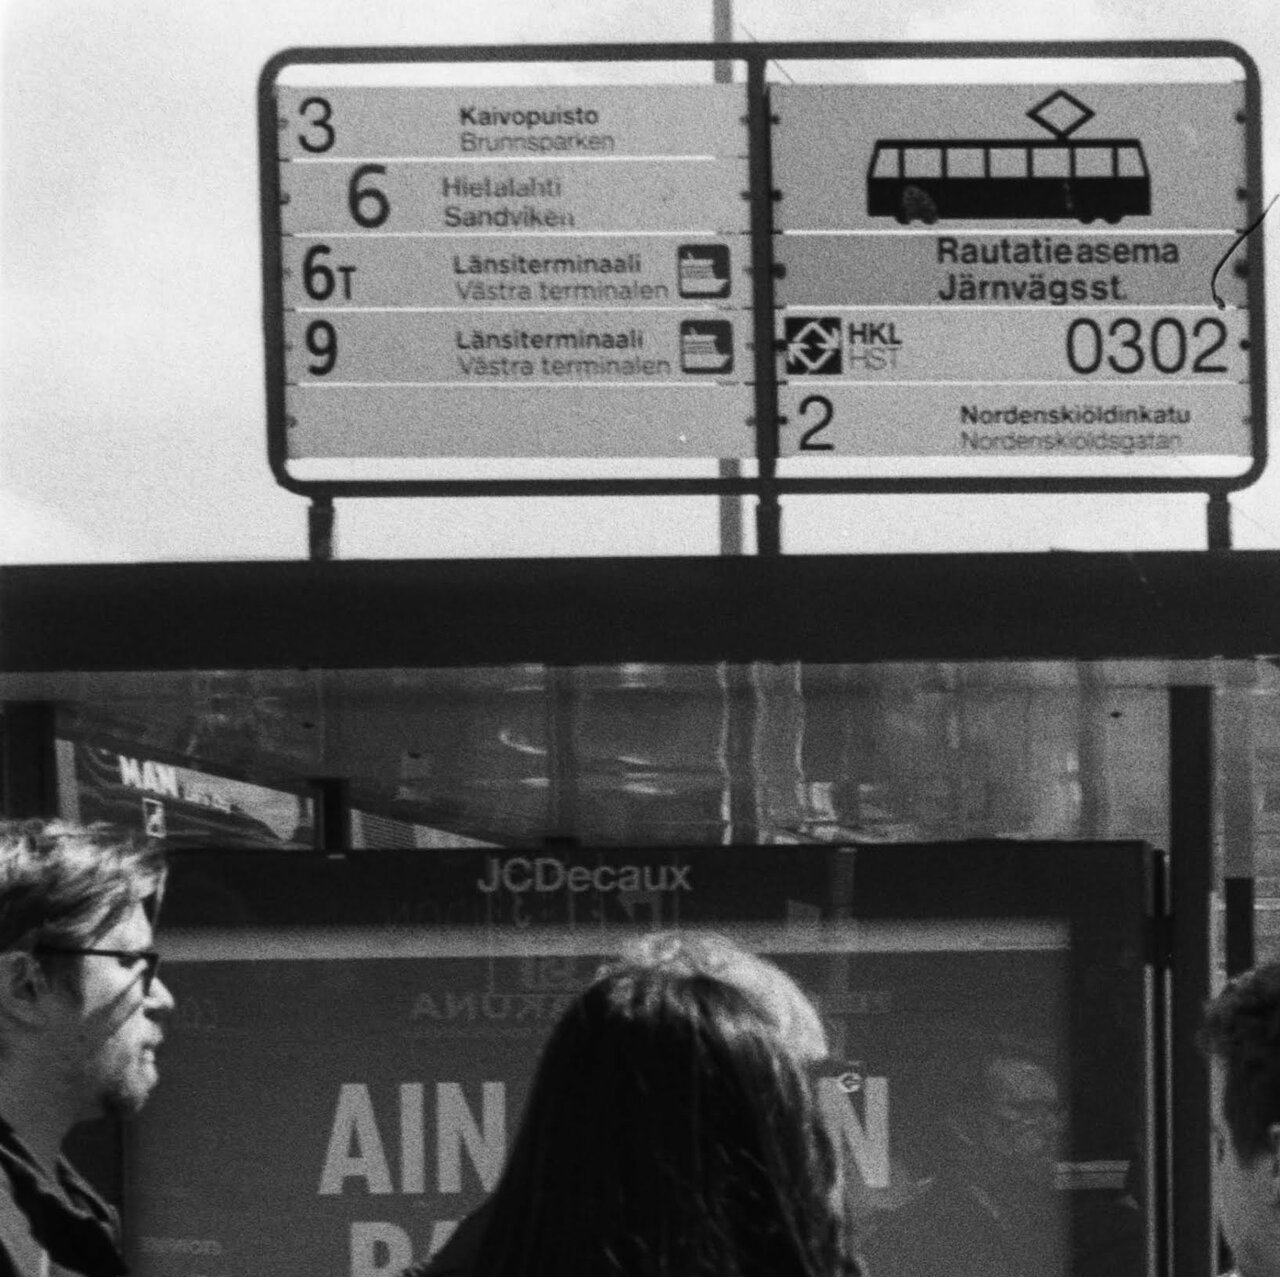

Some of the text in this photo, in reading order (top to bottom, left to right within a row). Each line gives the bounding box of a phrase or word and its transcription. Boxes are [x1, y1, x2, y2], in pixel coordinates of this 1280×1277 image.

[298, 97, 336, 154] 3
[459, 106, 600, 130] Kaivopuisto
[460, 131, 616, 154] Brunnsparken
[347, 163, 391, 229] 6
[441, 176, 563, 199] Hietalahti
[444, 204, 576, 229] Sandviken
[937, 236, 1180, 266] Rautatieasema
[452, 252, 642, 277] Länsiterminaali
[455, 278, 670, 301] Västra terminalen
[455, 327, 645, 352] Länsiterminaali
[848, 322, 903, 346] HKL
[1066, 317, 1229, 375] 0302
[304, 319, 338, 378] 9
[849, 346, 901, 372] HST
[458, 354, 672, 377] Västra terminalen
[798, 395, 836, 452] 2
[476, 857, 694, 894] JCDecaux
[317, 1081, 508, 1196] AIN
